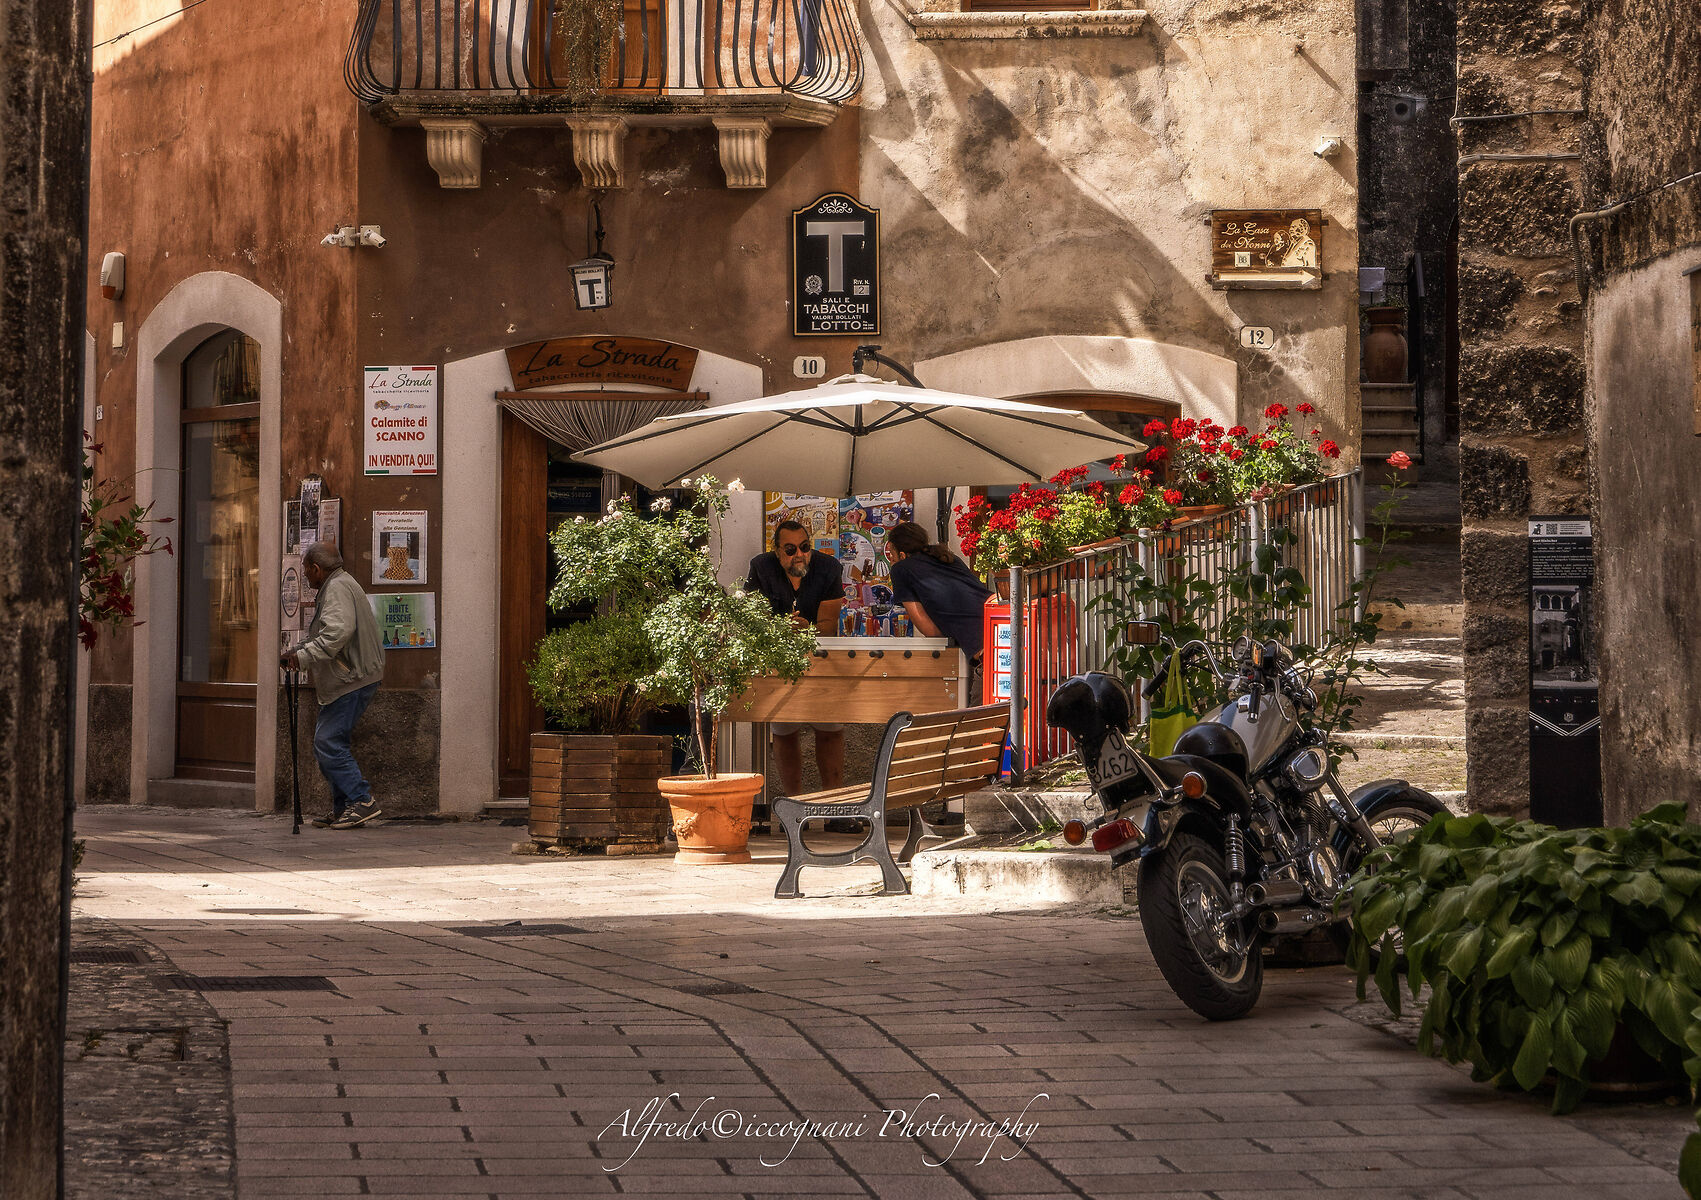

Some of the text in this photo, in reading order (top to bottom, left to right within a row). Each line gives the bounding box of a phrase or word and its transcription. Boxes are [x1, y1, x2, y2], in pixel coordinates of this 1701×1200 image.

[1221, 222, 1270, 235] La Casa
[1220, 236, 1272, 249] dei Nonni
[806, 220, 865, 292] T
[579, 278, 602, 305] T
[858, 286, 865, 295] 2
[803, 303, 869, 314] TABACCHI
[811, 320, 862, 331] LOTTO
[1249, 329, 1265, 345] 12
[518, 339, 681, 377] La Strada
[802, 359, 818, 375] 10
[368, 373, 433, 389] La Strada
[528, 371, 673, 383] tabaccheria ricevitoria
[371, 416, 428, 428] Calamite di
[375, 431, 425, 442] SCANNO
[368, 453, 435, 468] IN VENDITA QUI!
[388, 604, 409, 613] BIBITE
[385, 614, 412, 623] FRESCHE
